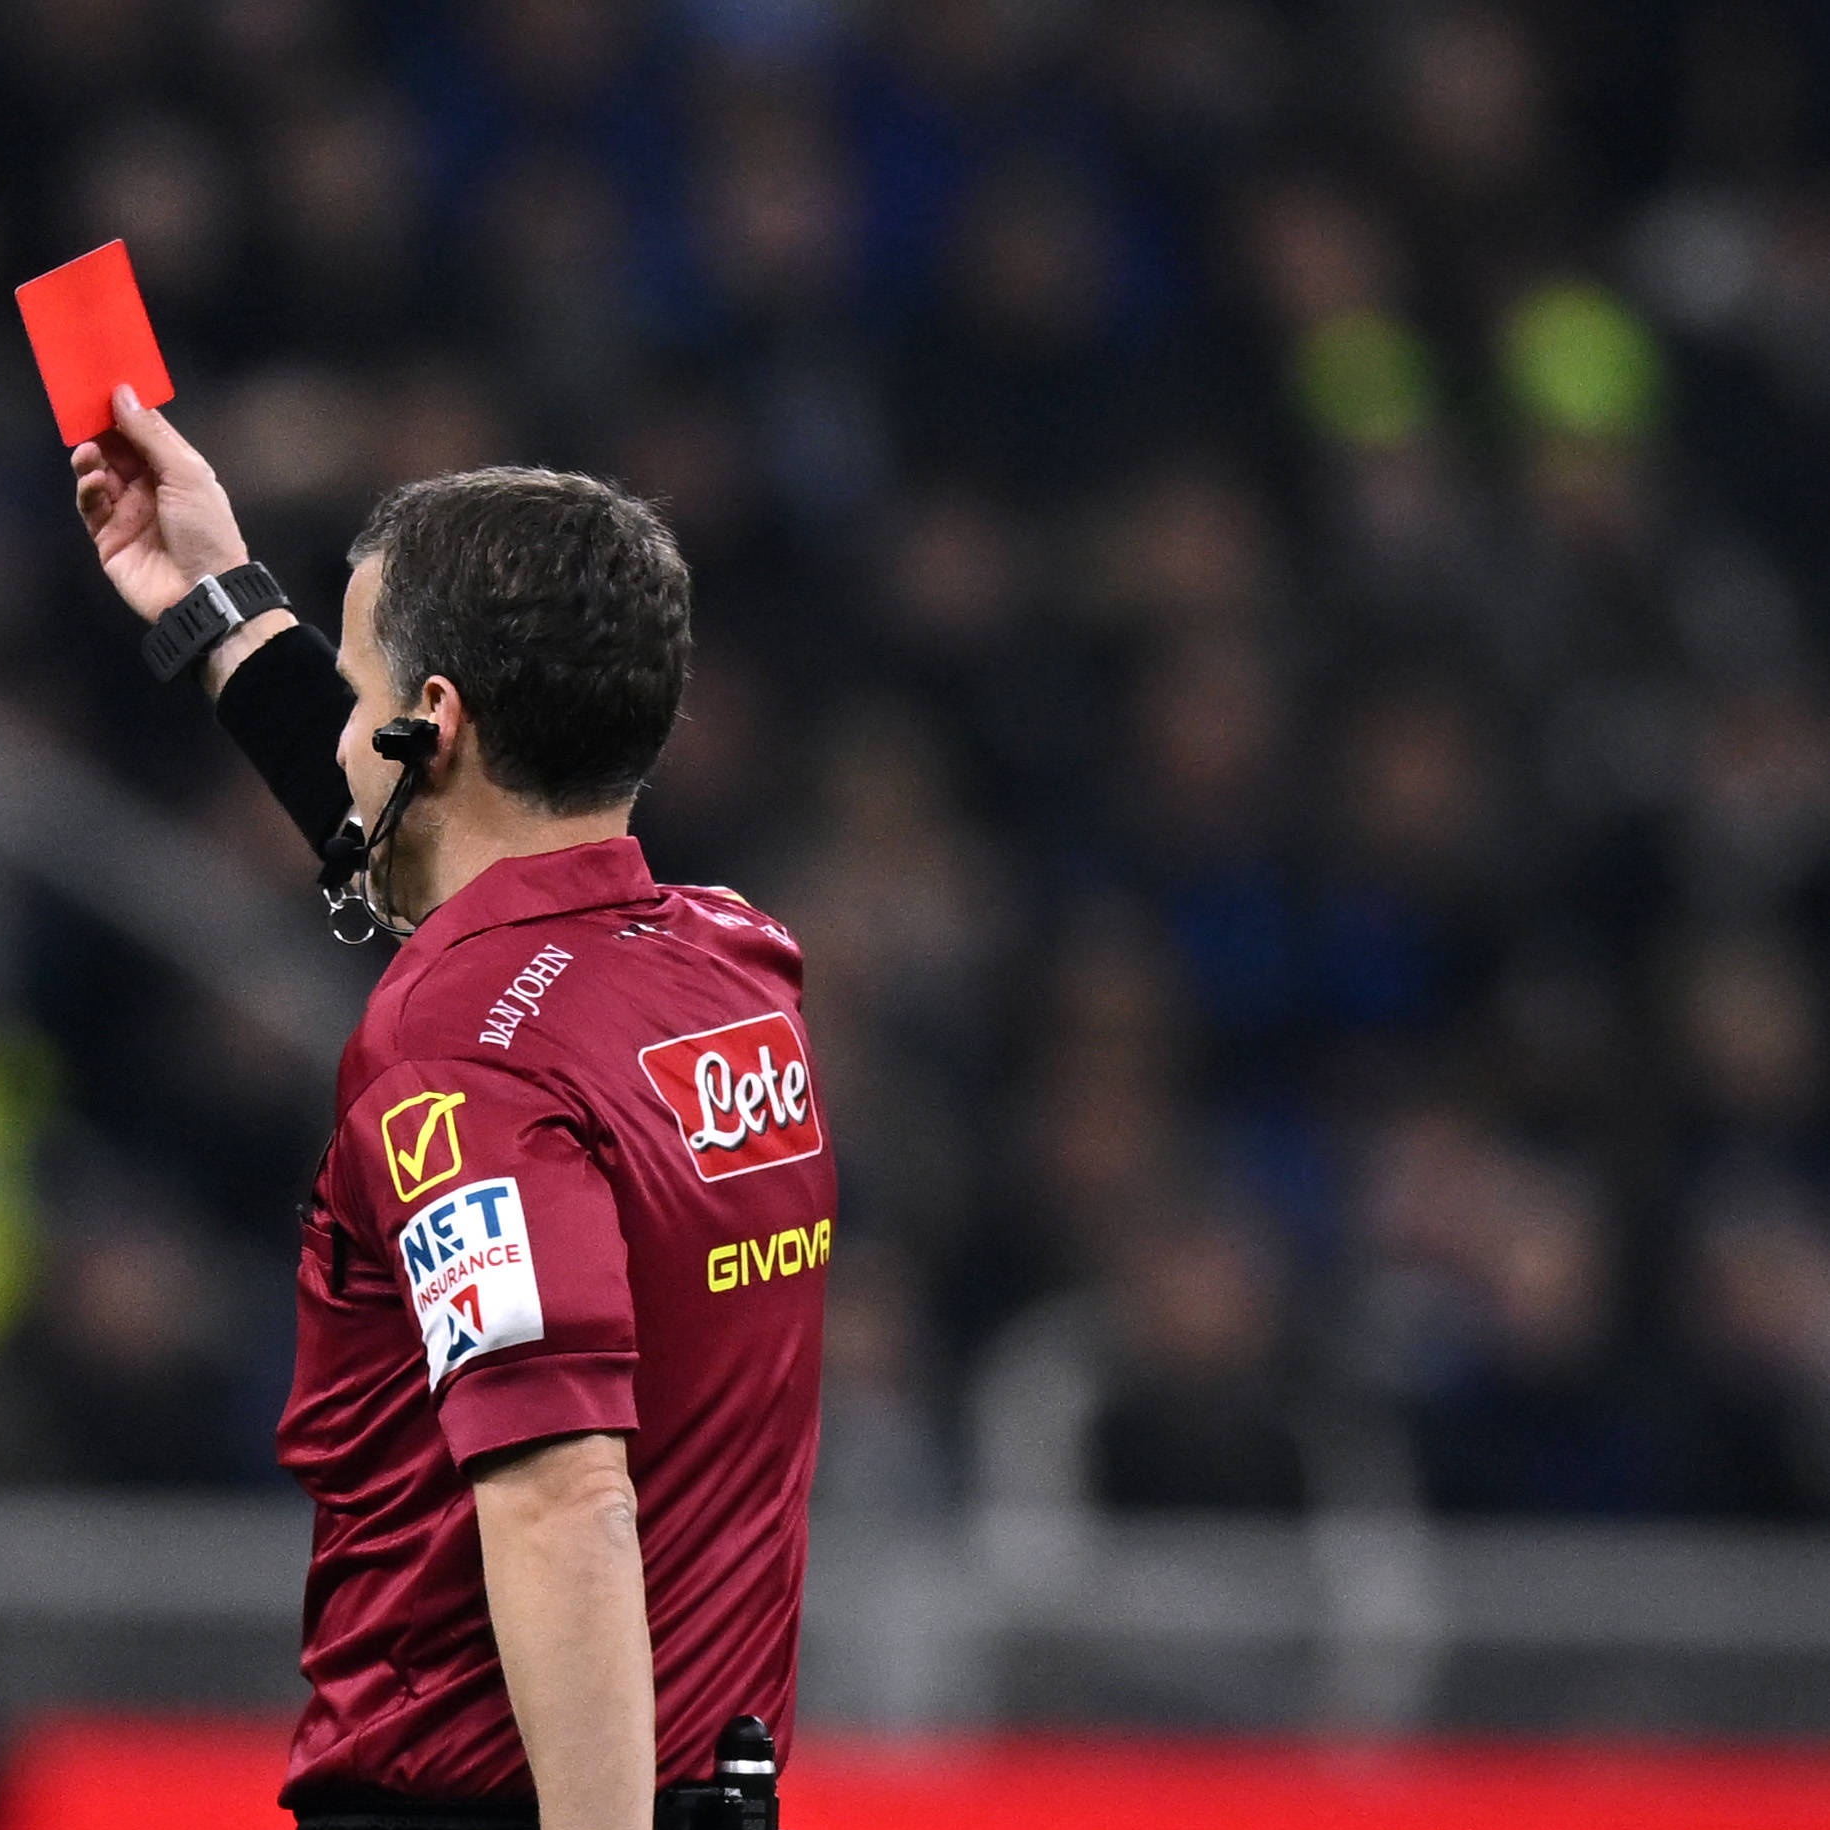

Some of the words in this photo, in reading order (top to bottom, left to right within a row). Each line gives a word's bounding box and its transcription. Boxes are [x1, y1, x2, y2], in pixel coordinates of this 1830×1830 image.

[479, 999, 526, 1050] DAN
[504, 944, 574, 1017] JOHN
[690, 1045, 807, 1151] Lete
[404, 1186, 509, 1286] NET
[417, 1244, 522, 1313] INSURANCE
[708, 1218, 832, 1293] GIVOVA
